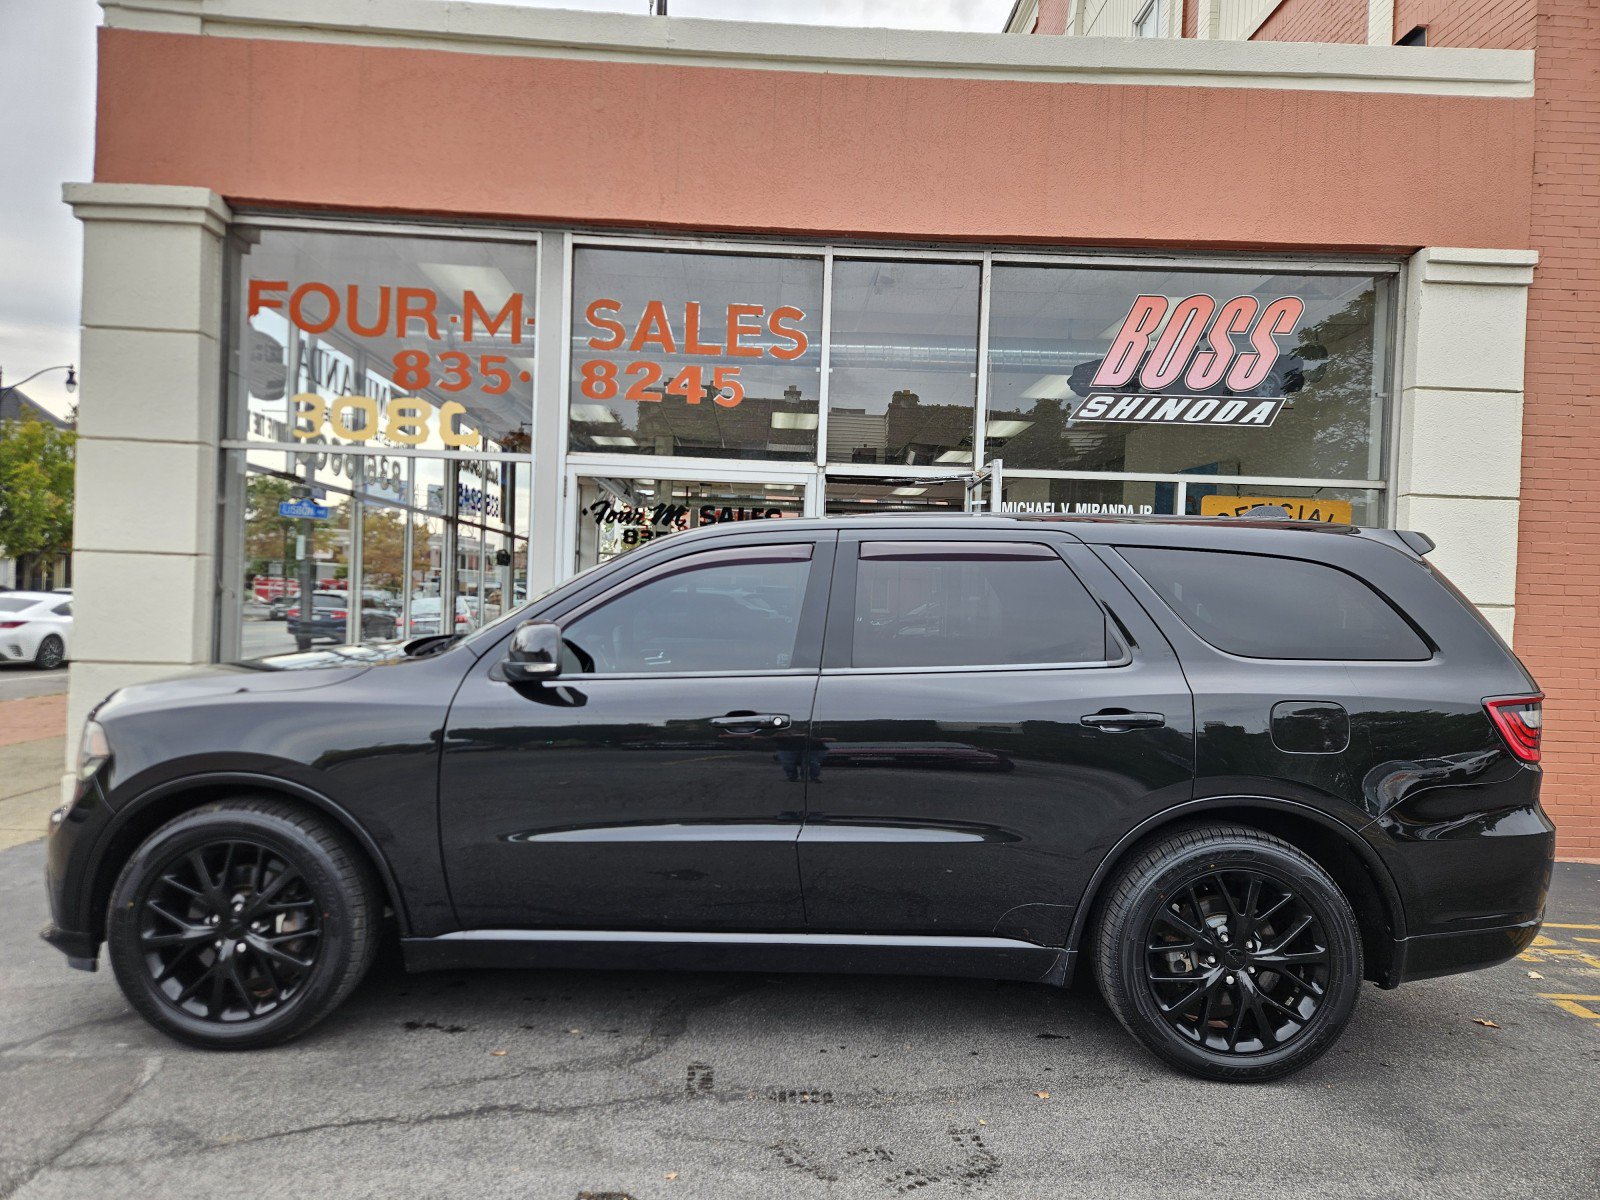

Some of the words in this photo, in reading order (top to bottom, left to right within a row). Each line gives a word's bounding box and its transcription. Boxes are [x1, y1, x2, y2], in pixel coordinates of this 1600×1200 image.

[247, 279, 442, 341] FOUR
[585, 298, 809, 361] SALES
[1090, 293, 1305, 392] BOSS
[580, 359, 746, 409] 8245
[1078, 396, 1278, 424] SHINODA
[623, 529, 669, 544] 83
